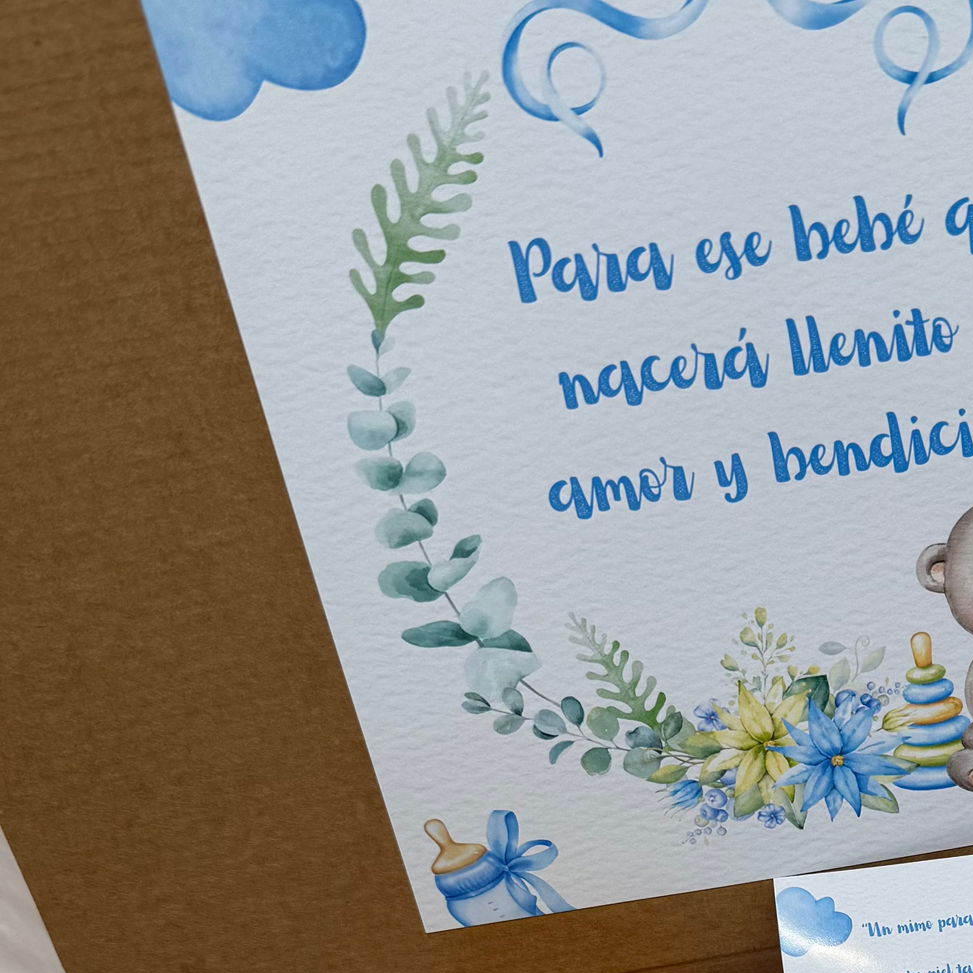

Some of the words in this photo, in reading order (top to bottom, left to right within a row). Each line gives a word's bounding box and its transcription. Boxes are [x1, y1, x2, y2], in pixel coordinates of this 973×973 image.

[508, 237, 674, 304] Para
[695, 231, 772, 281] ese
[787, 194, 924, 262] bebé
[558, 327, 769, 410] nacerá
[785, 308, 958, 377] llenito
[548, 456, 694, 520] amor
[713, 453, 748, 504] y
[897, 921, 932, 934] mimo
[938, 916, 973, 933] para
